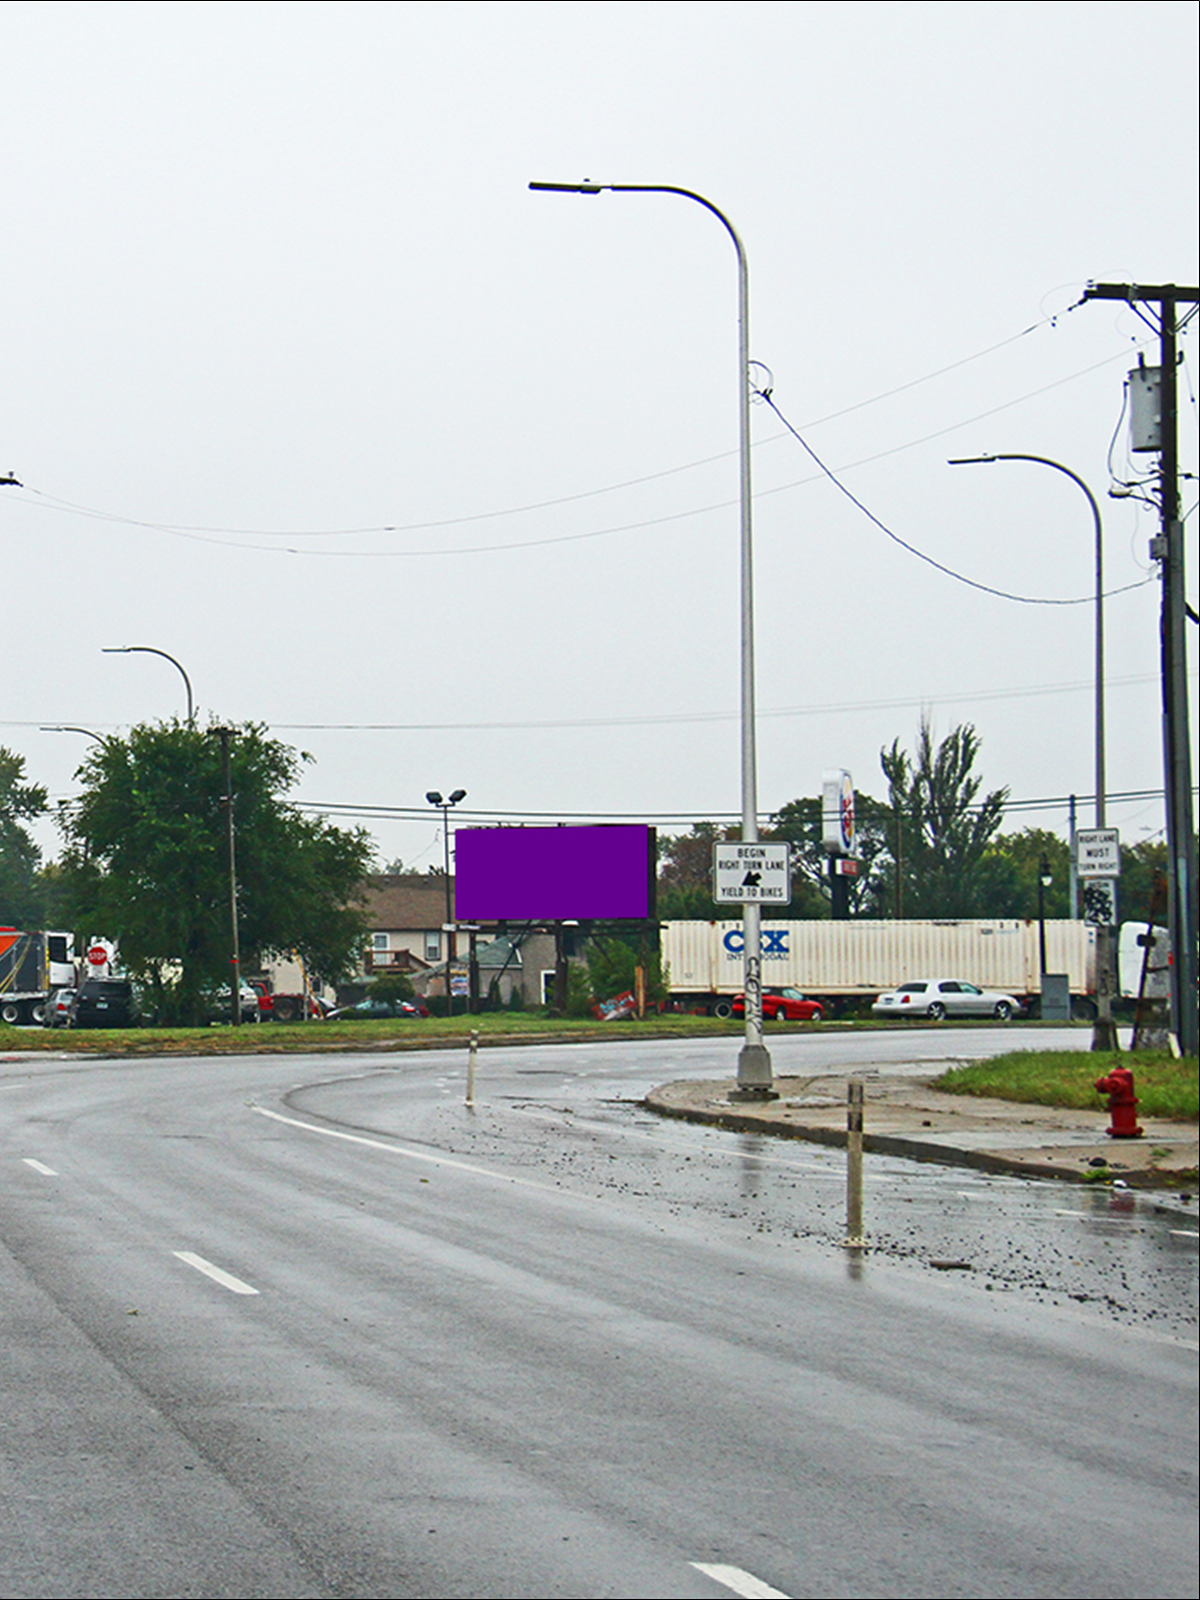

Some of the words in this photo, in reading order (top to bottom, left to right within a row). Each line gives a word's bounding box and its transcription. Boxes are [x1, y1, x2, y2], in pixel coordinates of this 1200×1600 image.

[1080, 835, 1097, 843] RIGHT
[1099, 835, 1115, 843] LANE
[737, 848, 766, 858] BEGIN
[1086, 848, 1109, 858] MUST
[719, 860, 740, 870] RIGHT
[743, 860, 762, 870] TURN
[765, 860, 785, 871] LANE
[1079, 863, 1096, 871] TURN
[1098, 862, 1117, 870] RIGHT
[721, 887, 743, 897] YIELD
[747, 887, 757, 897] TO
[760, 887, 783, 897] BIKES
[723, 929, 790, 953] CX
[89, 952, 106, 960] STOP
